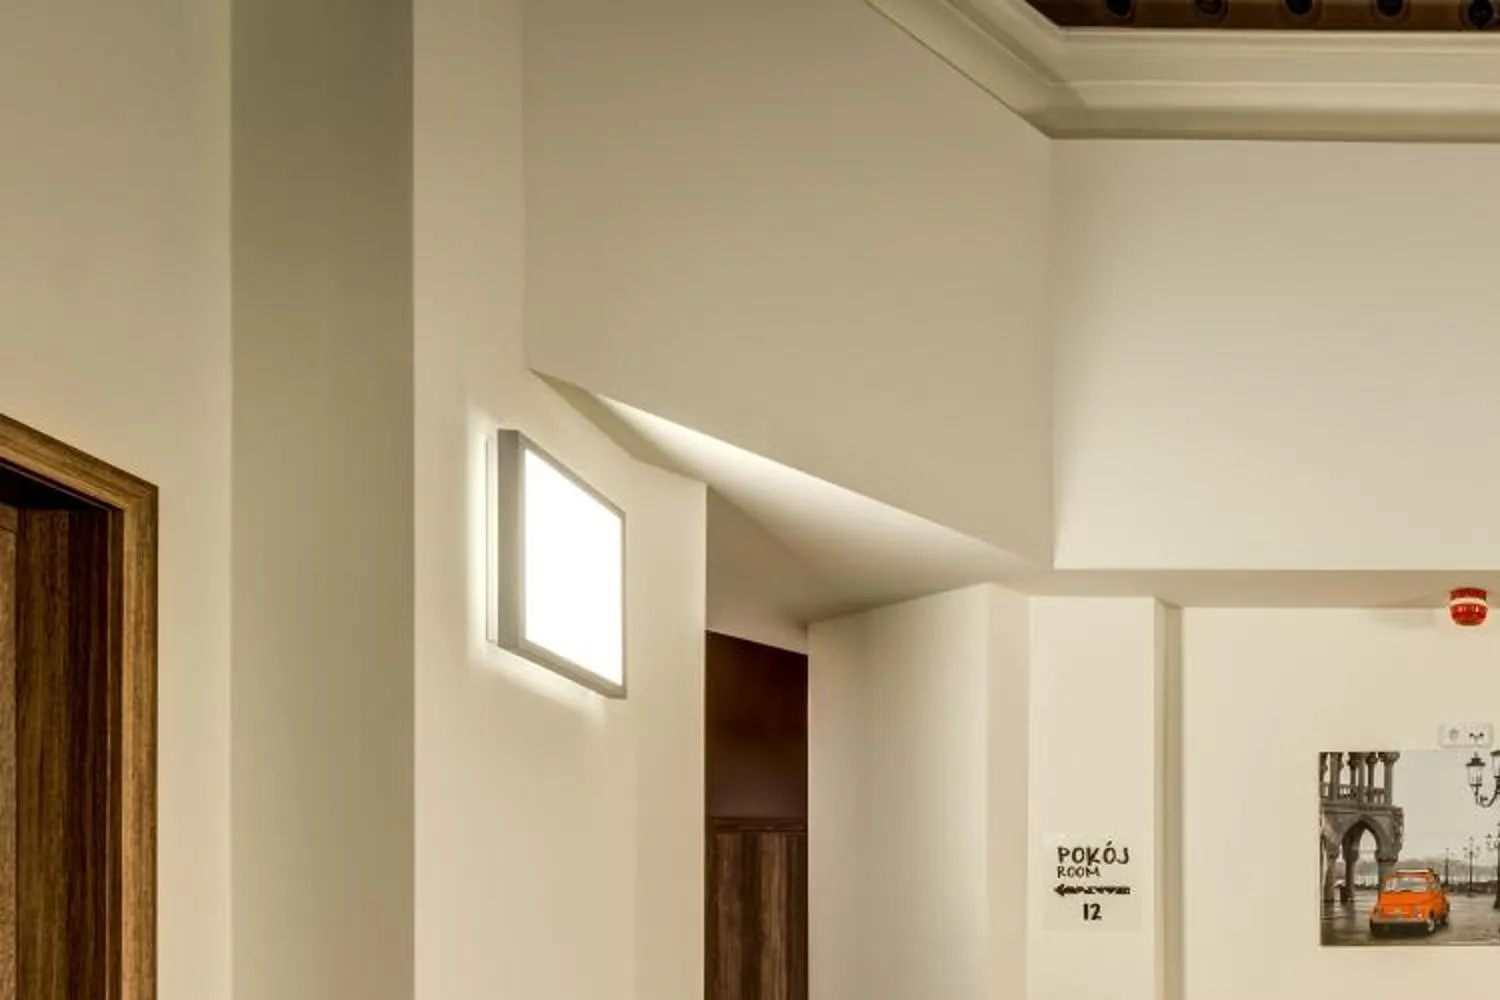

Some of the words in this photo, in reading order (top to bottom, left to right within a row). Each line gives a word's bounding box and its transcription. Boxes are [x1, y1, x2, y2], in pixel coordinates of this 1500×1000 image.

[1057, 840, 1129, 866] POKÓJ
[1056, 866, 1101, 878] ROOM
[1083, 903, 1103, 921] 12
